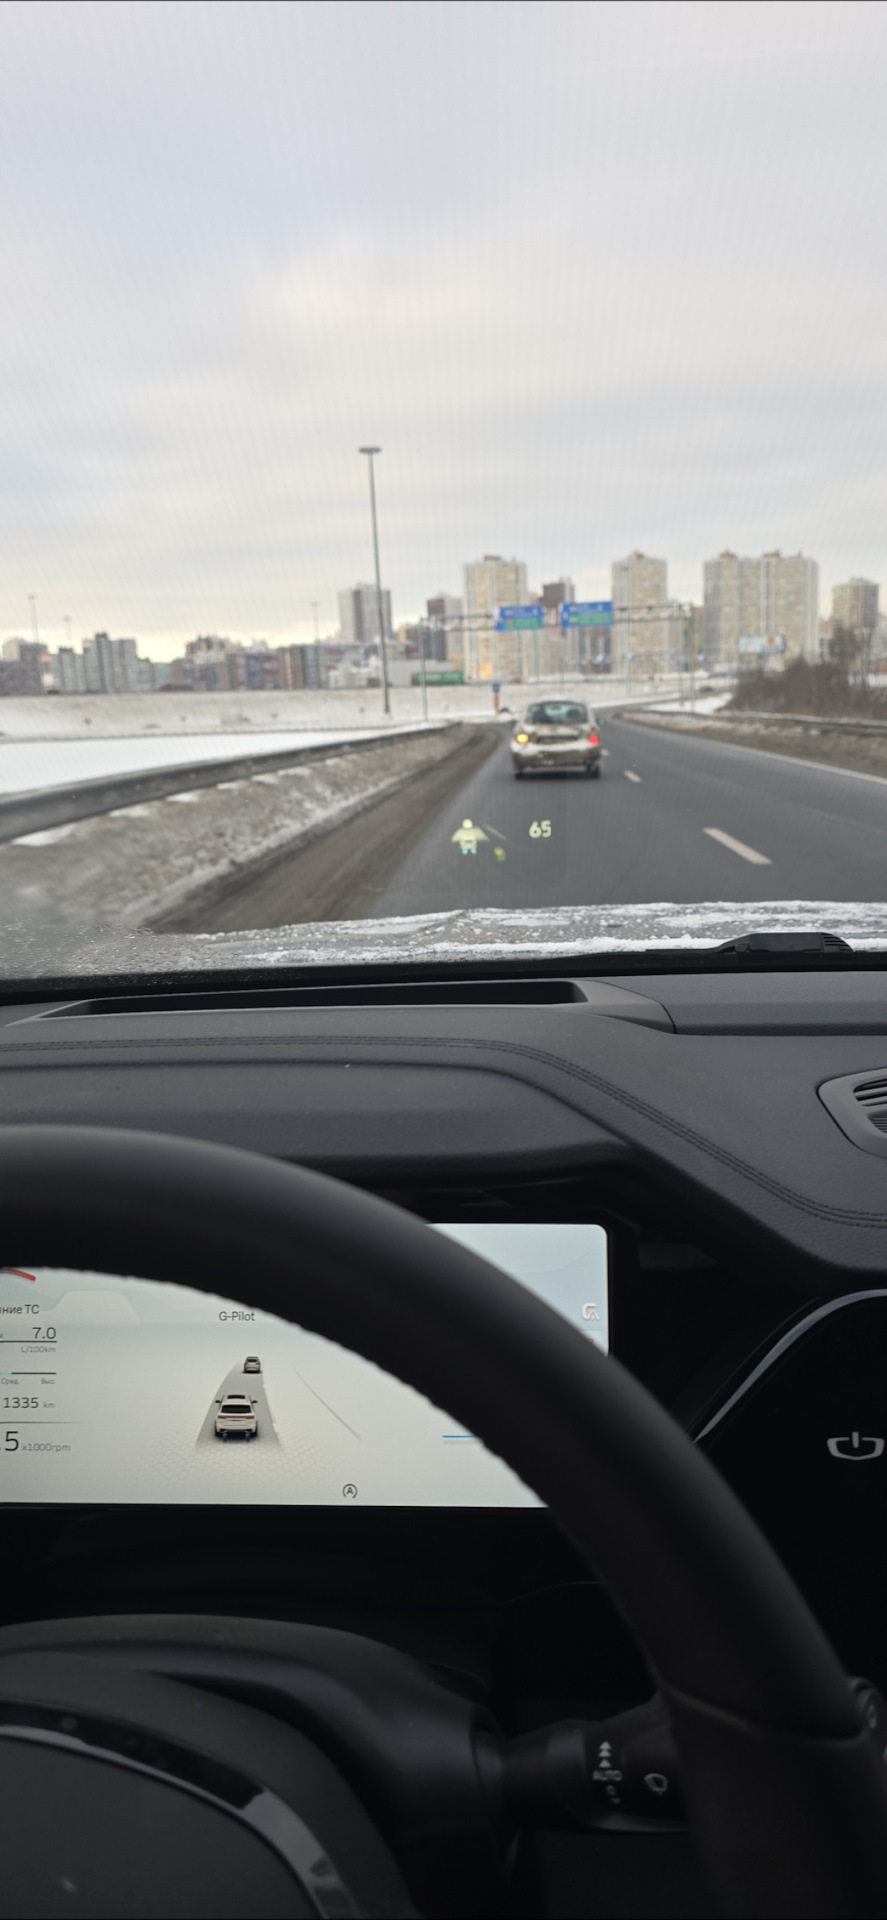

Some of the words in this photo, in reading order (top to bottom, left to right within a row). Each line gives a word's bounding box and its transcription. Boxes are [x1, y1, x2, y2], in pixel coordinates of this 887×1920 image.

[528, 820, 552, 838] 65
[24, 1304, 40, 1315] ТС
[219, 1310, 256, 1322] G-Pilot
[32, 1326, 57, 1340] 7.0
[3, 1396, 39, 1409] 1335
[43, 1401, 56, 1409] km
[592, 1769, 622, 1781] AUTO
